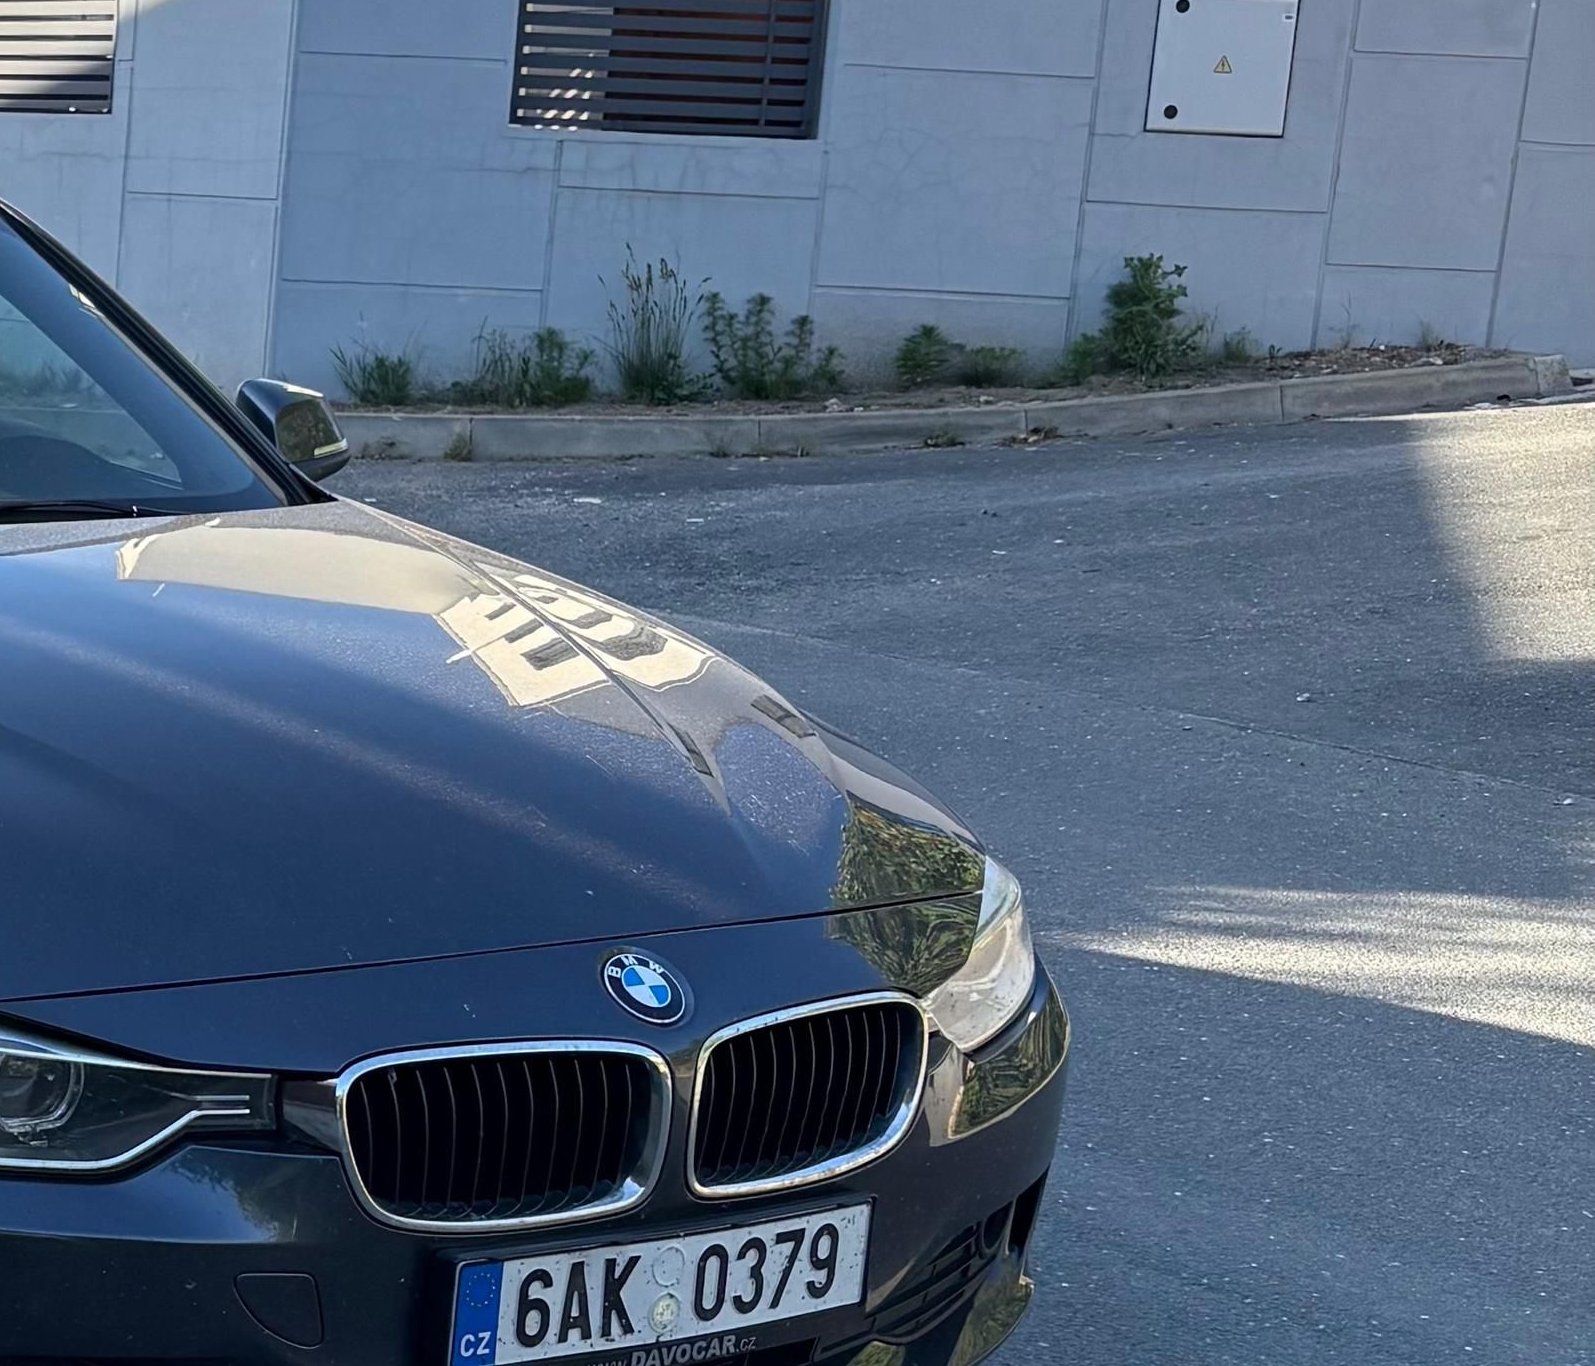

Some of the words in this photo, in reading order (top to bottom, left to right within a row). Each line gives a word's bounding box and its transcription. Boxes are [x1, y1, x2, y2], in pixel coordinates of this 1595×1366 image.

[608, 955, 664, 978] BMW
[514, 1255, 641, 1347] 6AK
[693, 1223, 839, 1322] 0379
[460, 1331, 490, 1357] CZ
